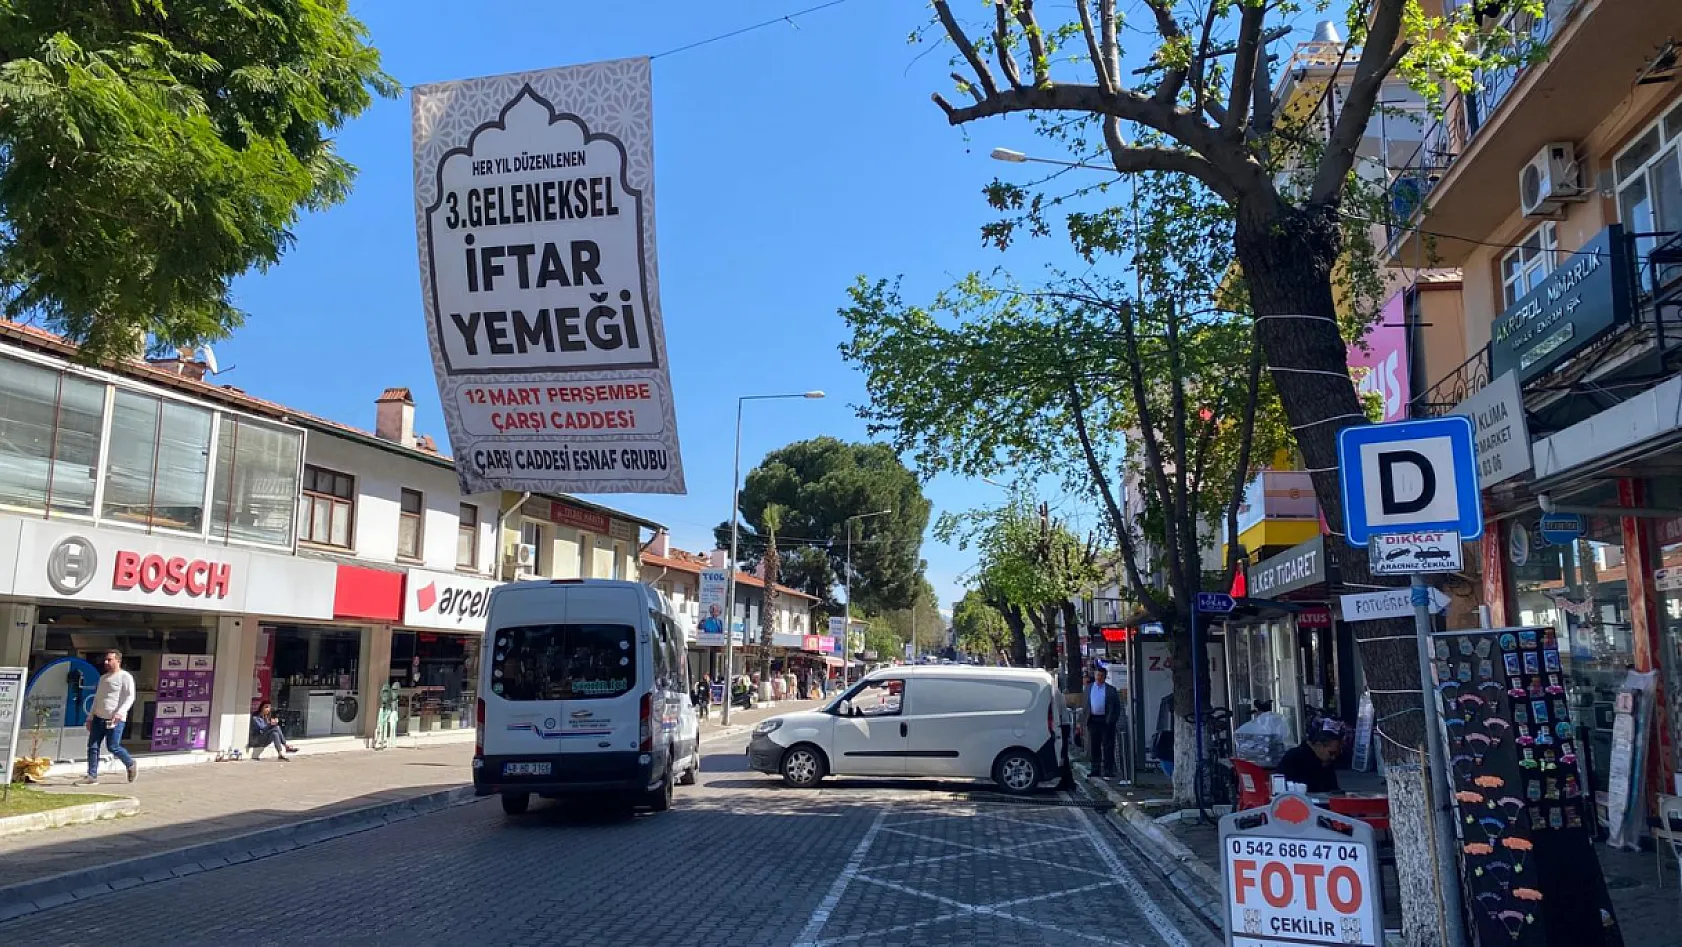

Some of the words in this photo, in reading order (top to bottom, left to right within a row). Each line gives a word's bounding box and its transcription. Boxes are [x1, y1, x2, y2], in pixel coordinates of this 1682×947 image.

[472, 159, 493, 176] HER
[495, 157, 512, 174] YIL
[513, 150, 586, 172] DÜZENLENEN
[446, 176, 619, 229] 3.GELENEKSEL
[464, 233, 604, 292] İFTAR
[450, 289, 641, 356] YEMEĞİ
[1496, 296, 1542, 342] AKROPOL
[465, 388, 487, 404] 12
[489, 387, 541, 406] MART
[546, 383, 650, 405] PERŞEMBE
[491, 411, 547, 433] ÇARŞI
[550, 409, 636, 430] CADDESİ
[474, 449, 513, 475] ÇARŞI
[515, 444, 570, 471] CADDESİ
[572, 449, 617, 472] ESNAF
[621, 449, 668, 471] GRUBU
[1378, 449, 1437, 516] D
[112, 550, 231, 599] BOSCH
[1232, 840, 1241, 854] 0
[1246, 841, 1273, 856] 542
[1279, 843, 1307, 858] 686
[1312, 845, 1332, 859] 47
[1338, 846, 1358, 861] 04
[1233, 859, 1363, 914] FOTO
[1270, 916, 1336, 937] ÇEKİLİR
